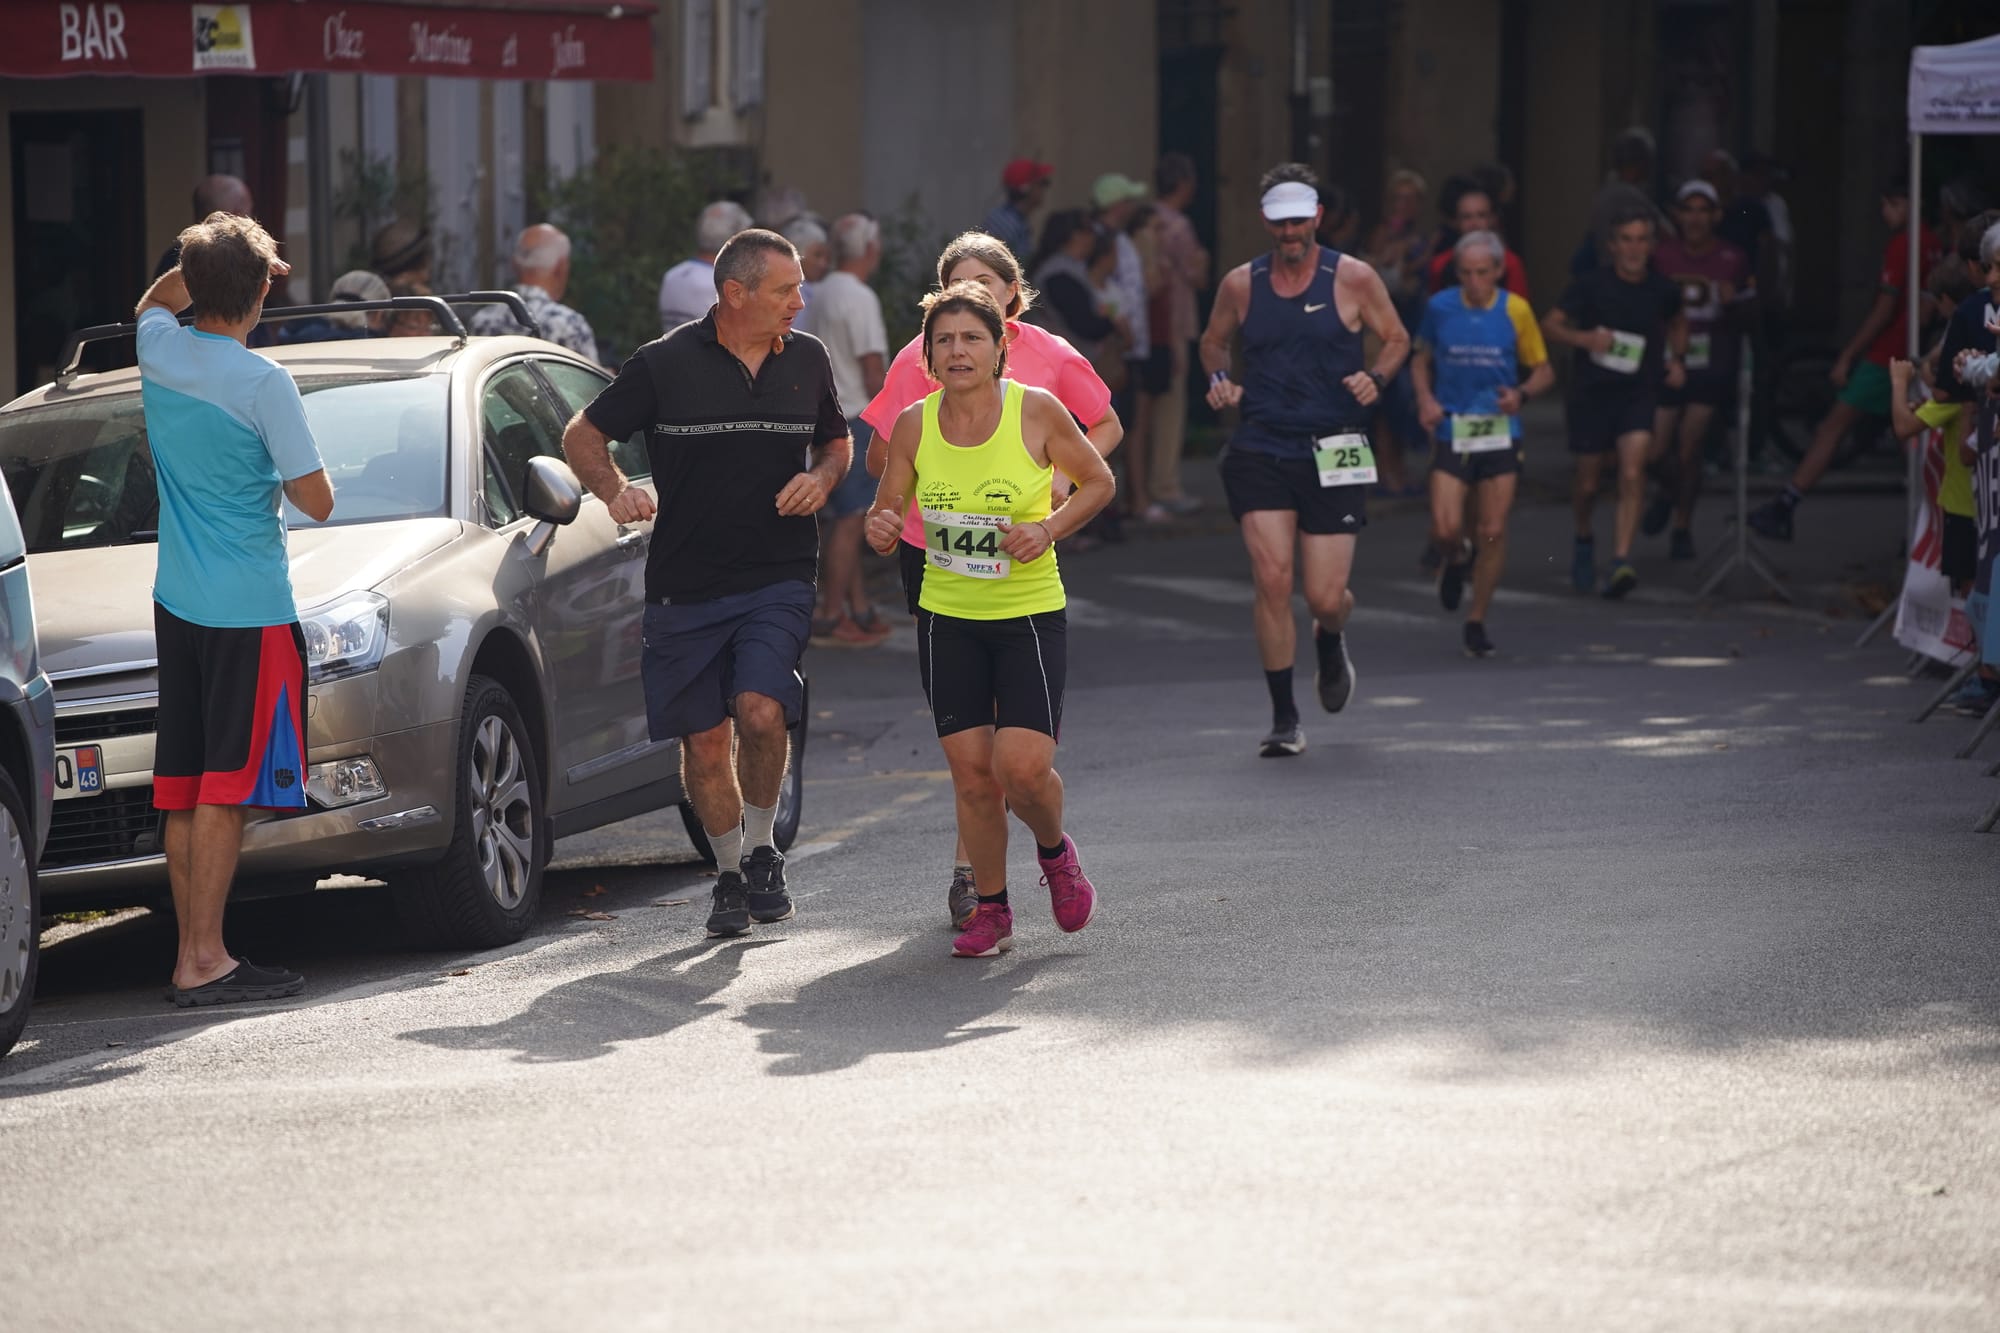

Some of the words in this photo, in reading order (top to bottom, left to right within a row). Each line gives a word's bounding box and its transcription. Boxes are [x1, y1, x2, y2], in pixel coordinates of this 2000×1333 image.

[60, 4, 128, 61] BAR
[323, 10, 365, 62] Chez
[1334, 448, 1361, 468] 25
[935, 527, 998, 557] 144
[966, 562, 993, 571] TUFF'S
[80, 770, 98, 788] 48
